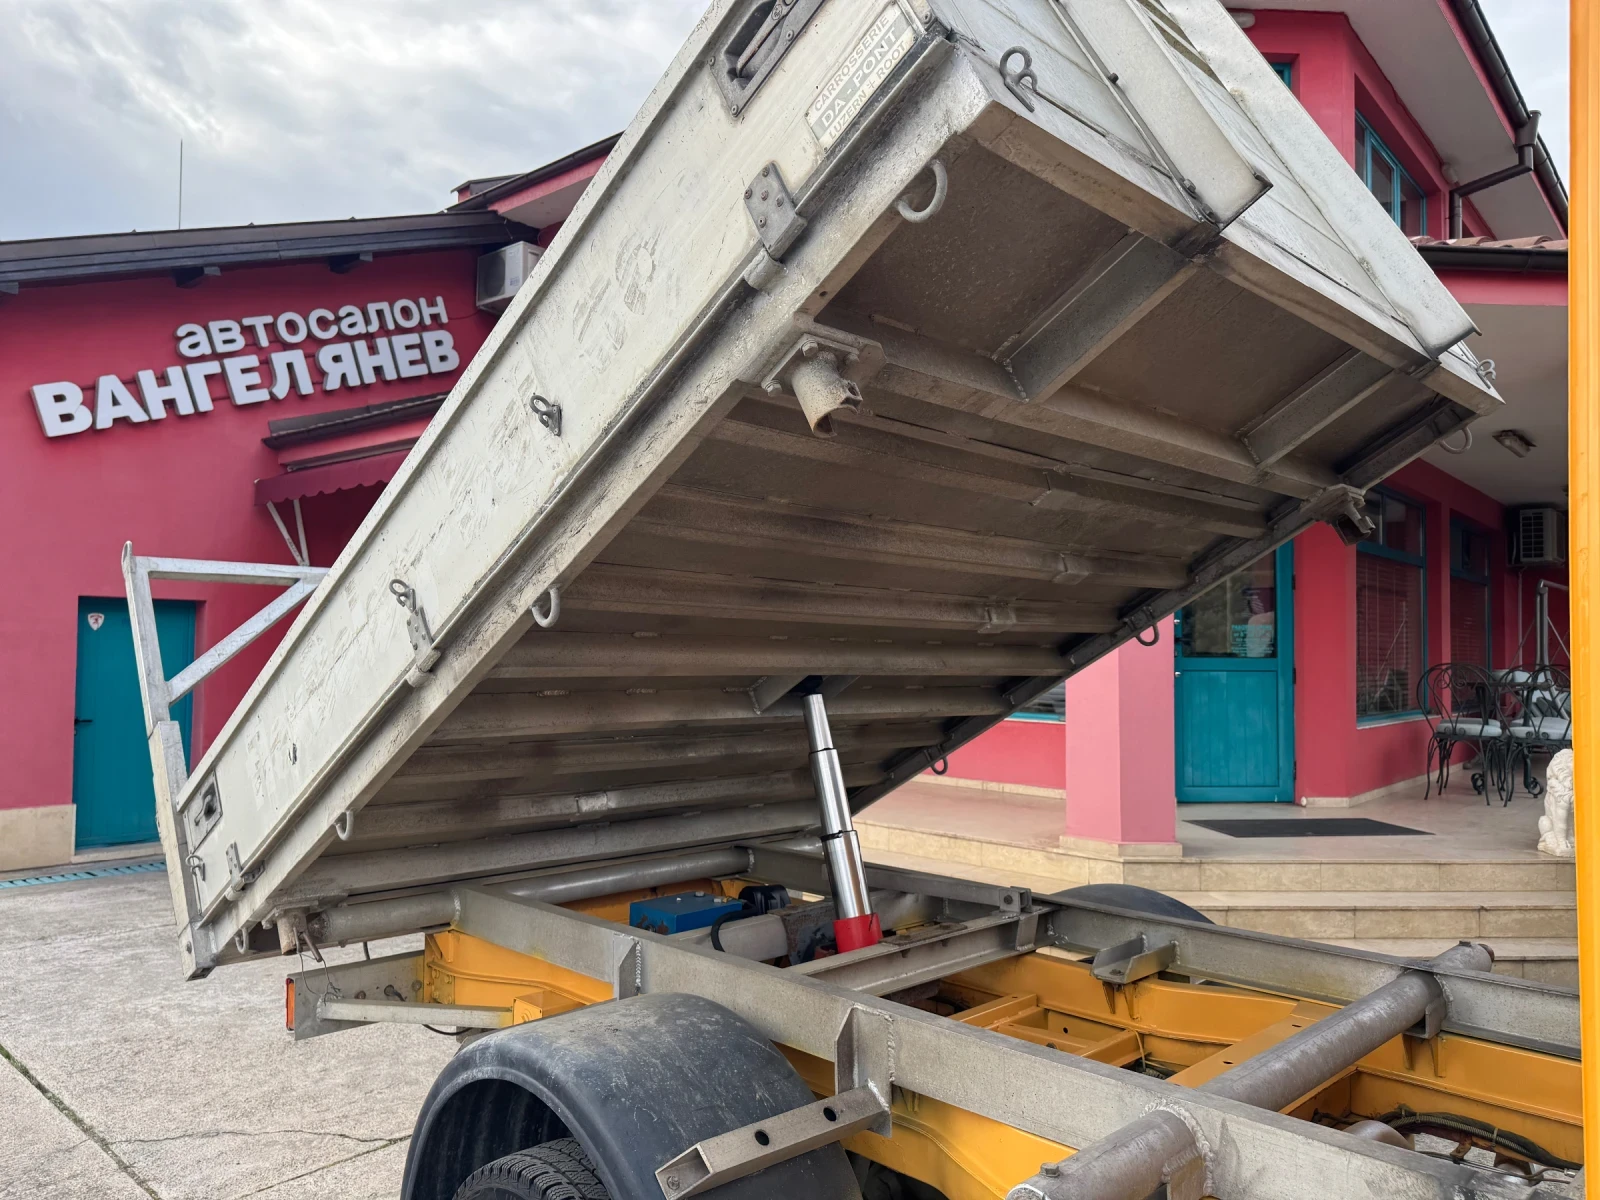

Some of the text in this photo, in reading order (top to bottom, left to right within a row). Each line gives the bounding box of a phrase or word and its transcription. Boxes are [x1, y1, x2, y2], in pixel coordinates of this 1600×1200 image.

[814, 14, 889, 113] CARROSSERIE
[829, 90, 867, 139] LUZERN
[876, 40, 906, 80] ROOT
[175, 296, 448, 357] автосалон
[30, 330, 460, 437] ВАНГЕЛ ЯНЕВ
